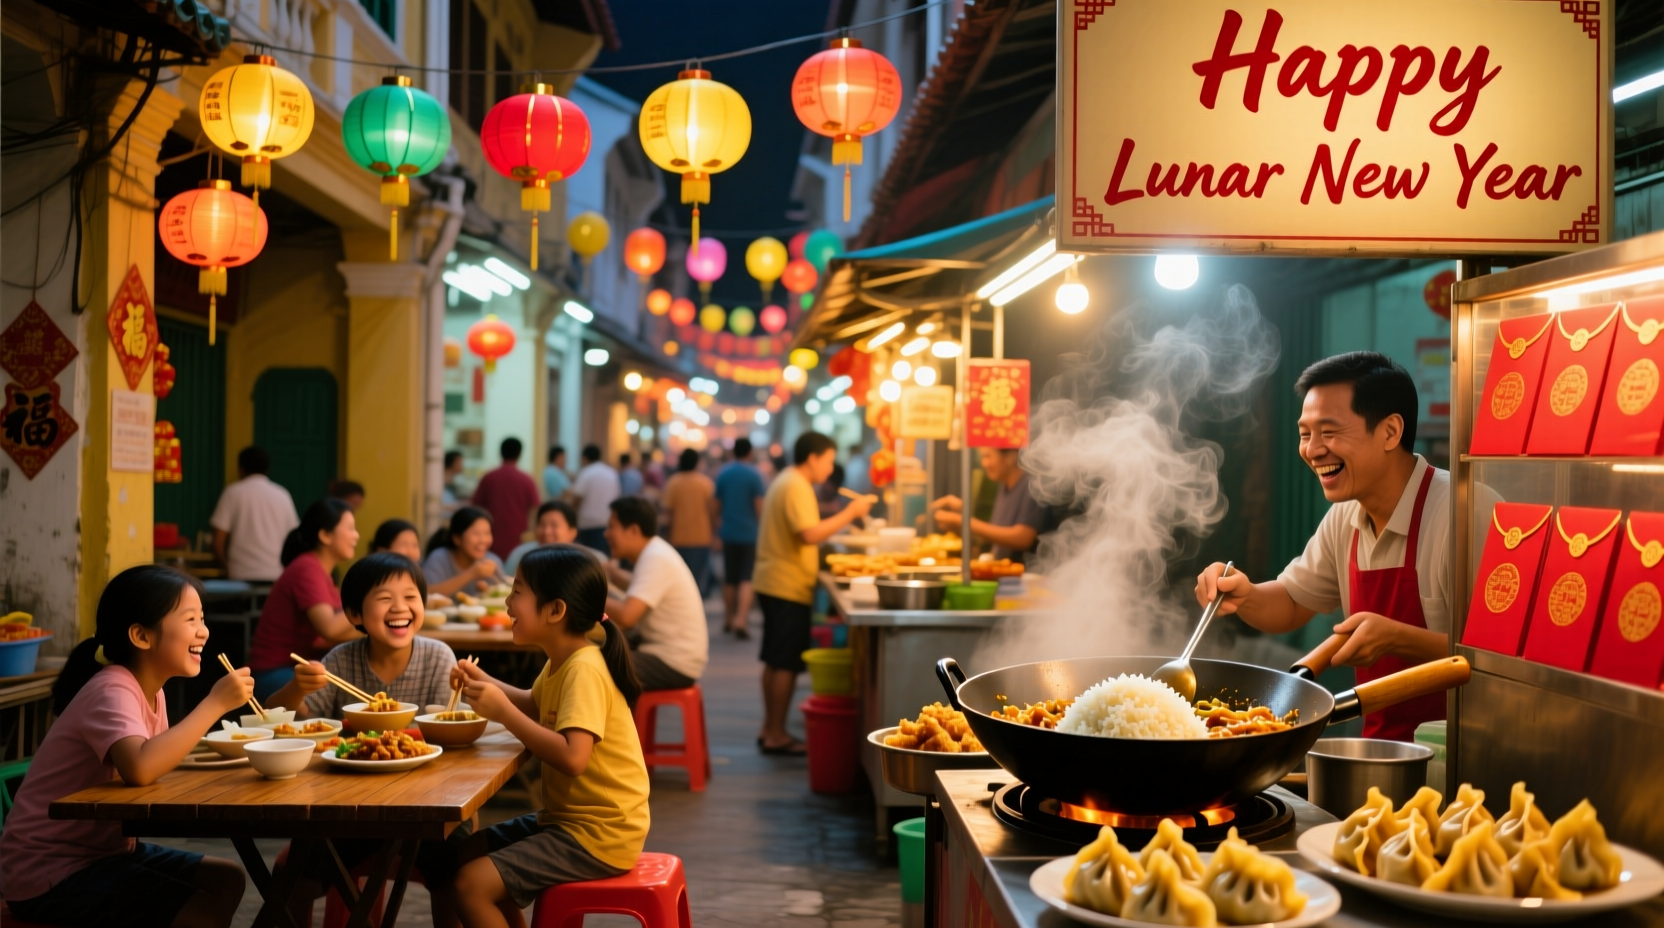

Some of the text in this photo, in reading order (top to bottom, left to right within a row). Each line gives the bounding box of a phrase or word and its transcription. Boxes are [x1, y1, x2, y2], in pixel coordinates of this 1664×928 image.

[1192, 8, 1502, 137] Happy
[1104, 137, 1583, 210] Lunar New Year
[122, 302, 147, 359] 福
[2, 391, 59, 448] 福
